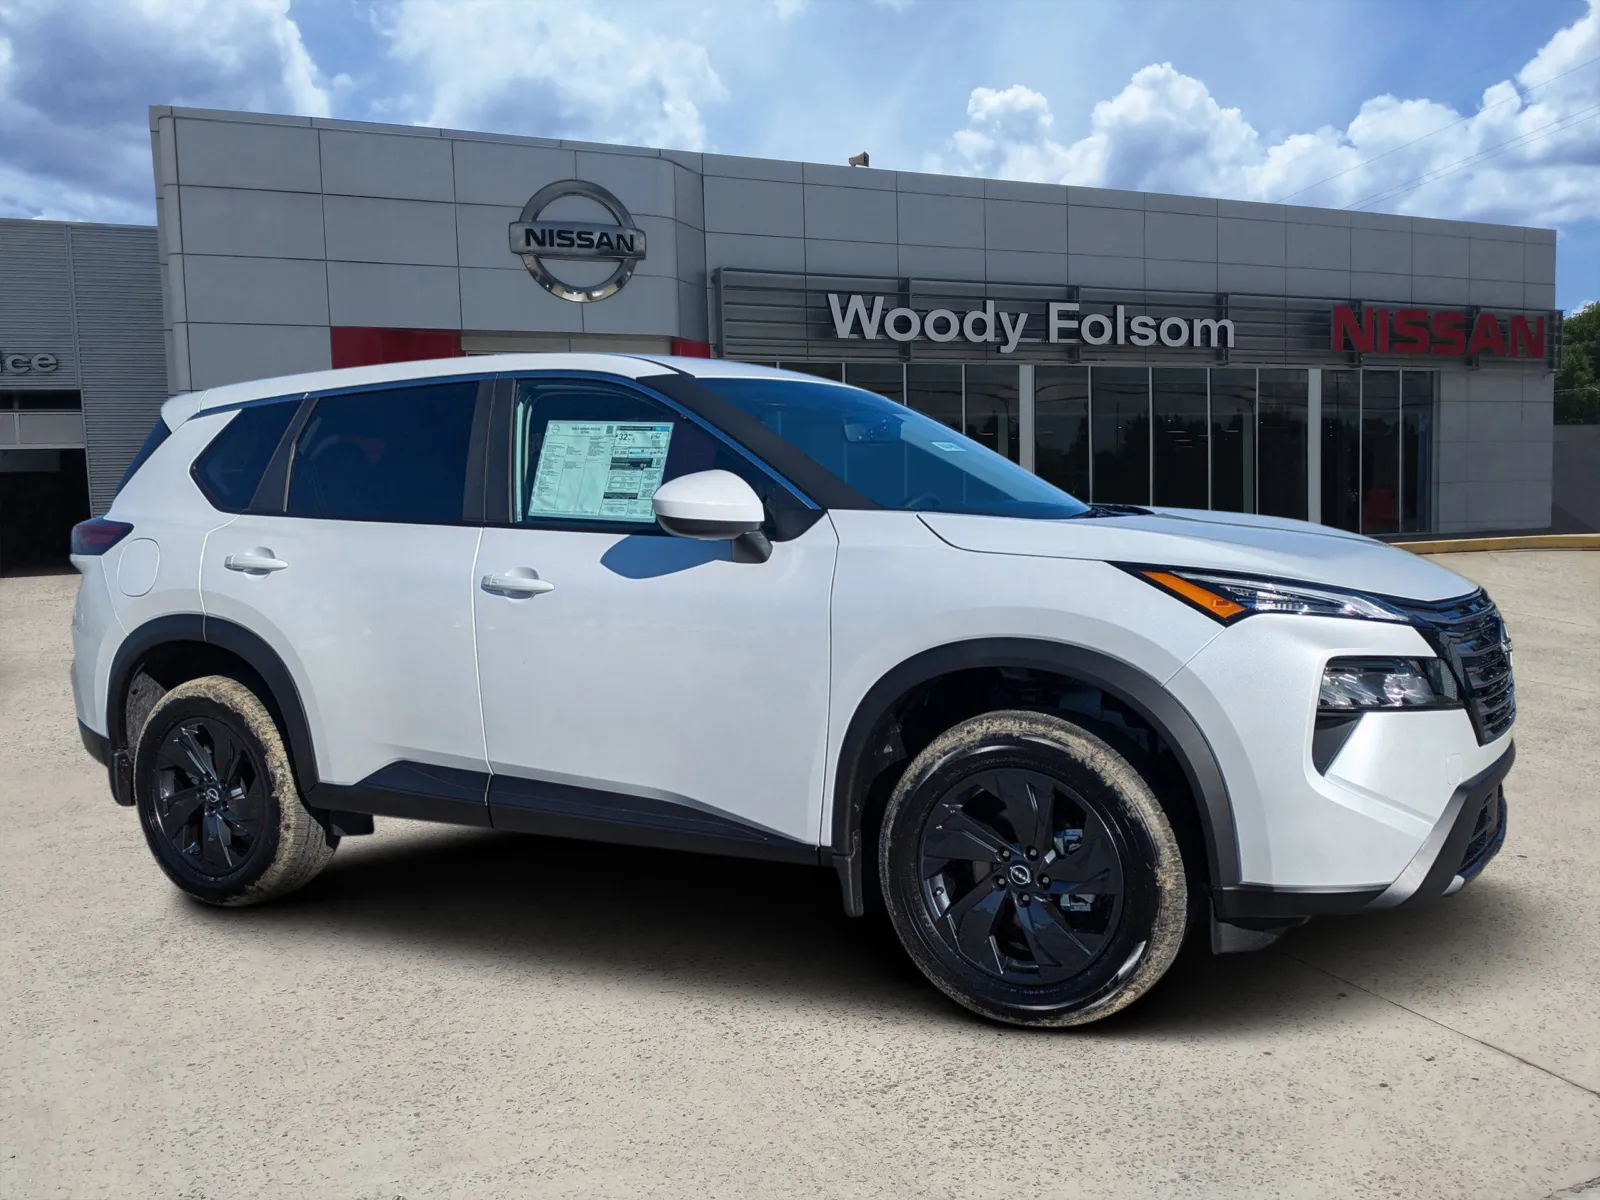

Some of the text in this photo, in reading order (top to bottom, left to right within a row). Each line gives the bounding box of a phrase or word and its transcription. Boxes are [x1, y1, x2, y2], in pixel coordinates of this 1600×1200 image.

[525, 228, 634, 252] NISSAN
[827, 293, 1544, 358] Woody Folsom NISSAN
[0, 353, 57, 373] ce
[619, 433, 628, 441] 32
